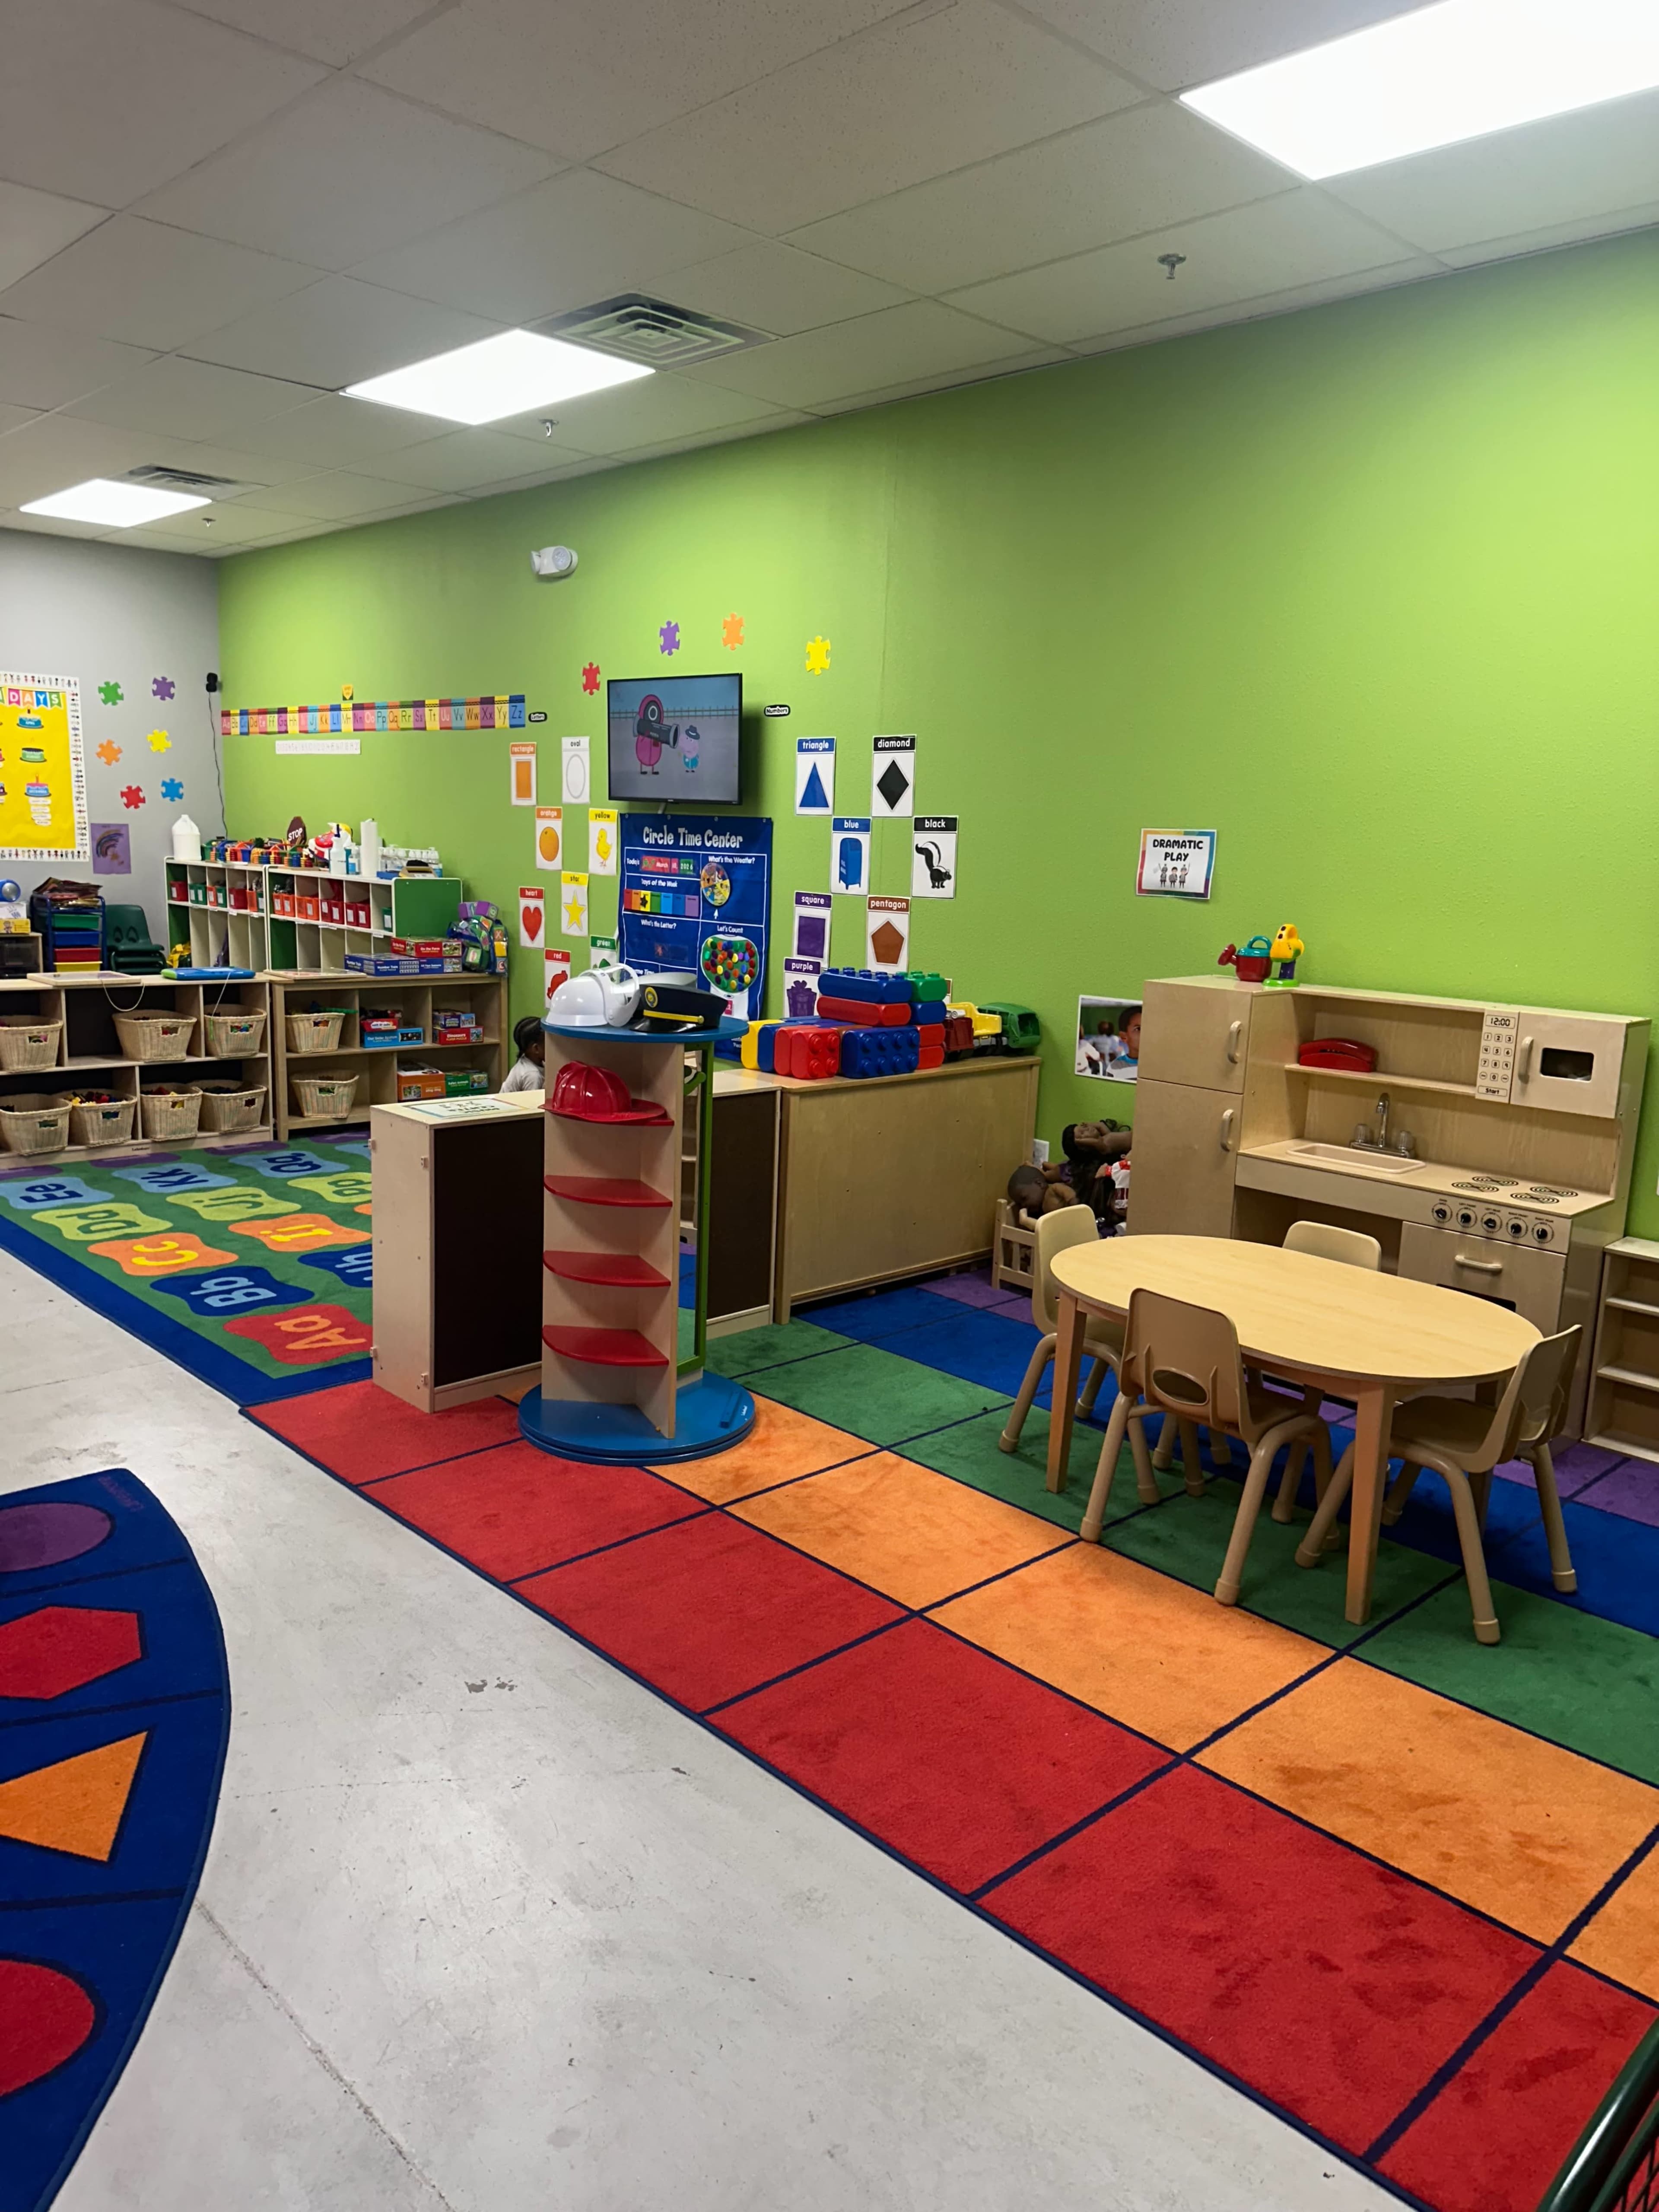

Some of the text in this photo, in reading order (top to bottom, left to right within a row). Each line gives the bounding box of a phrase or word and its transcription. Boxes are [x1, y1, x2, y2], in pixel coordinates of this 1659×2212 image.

[401, 710, 411, 721] Rr
[482, 707, 493, 720] Xx
[497, 706, 507, 725] Yy
[511, 705, 522, 719] Zz
[803, 741, 829, 751] triangle
[878, 738, 910, 748] diamond
[594, 811, 610, 820] yellow
[844, 820, 859, 828] blue
[925, 819, 946, 829] black
[288, 828, 303, 841] STOP
[643, 825, 743, 848] Circle Time Center
[1153, 839, 1204, 850] DRAMATIC
[1164, 852, 1189, 862] PLAY
[801, 896, 824, 905] square
[871, 900, 906, 910] pentagon
[660, 921, 677, 929] Letter?
[792, 962, 813, 972] purple
[1491, 1017, 1510, 1027] 12:00
[141, 1168, 209, 1187] Kk
[19, 1183, 84, 1203] Ee
[193, 1193, 264, 1209] Jj
[56, 1210, 142, 1234] Dd
[260, 1224, 333, 1243] Ii
[131, 1241, 199, 1266] Cc
[190, 1276, 277, 1307] Bb
[274, 1315, 367, 1350] Aa
